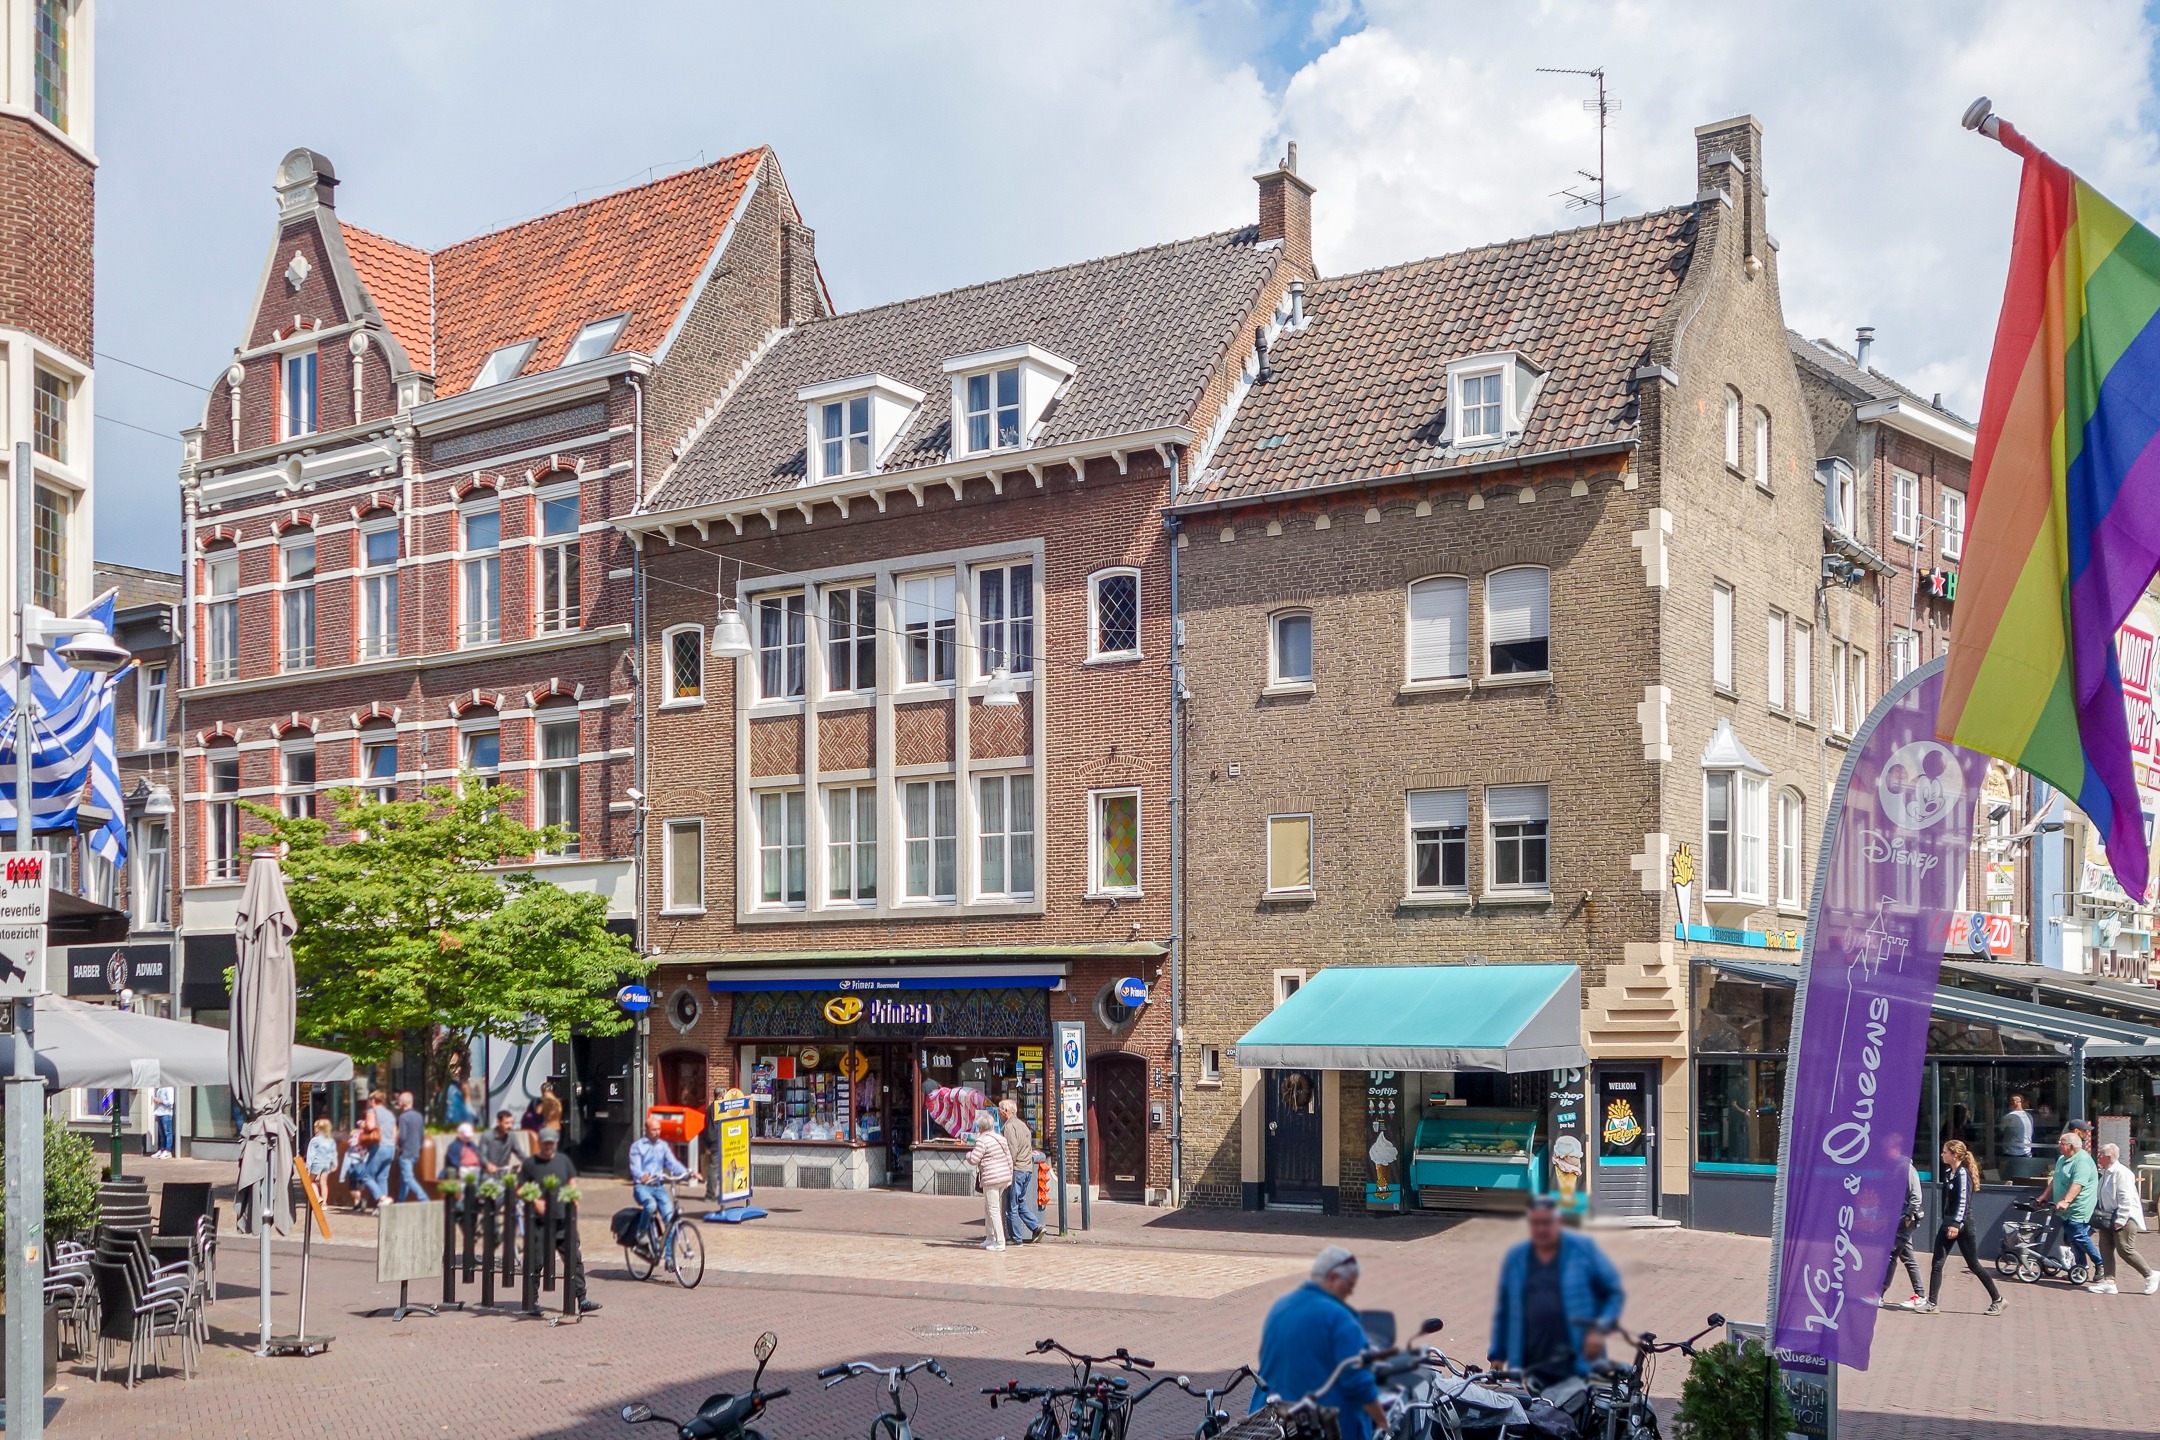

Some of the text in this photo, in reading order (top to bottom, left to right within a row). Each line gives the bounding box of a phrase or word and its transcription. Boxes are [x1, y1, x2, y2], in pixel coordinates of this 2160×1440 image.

[73, 962, 163, 978] BARBER ADWAR
[852, 981, 875, 989] Primera
[870, 998, 932, 1024] Primera
[1609, 1082, 1637, 1090] WELKOM
[1822, 997, 1890, 1165] Queens
[1368, 1087, 1398, 1096] Softijs
[1550, 1092, 1584, 1100] Schep
[736, 1177, 748, 1190] 21
[1843, 1173, 1862, 1196] &
[1804, 1205, 1863, 1332] Kings
[1791, 1405, 1825, 1424] HOP
